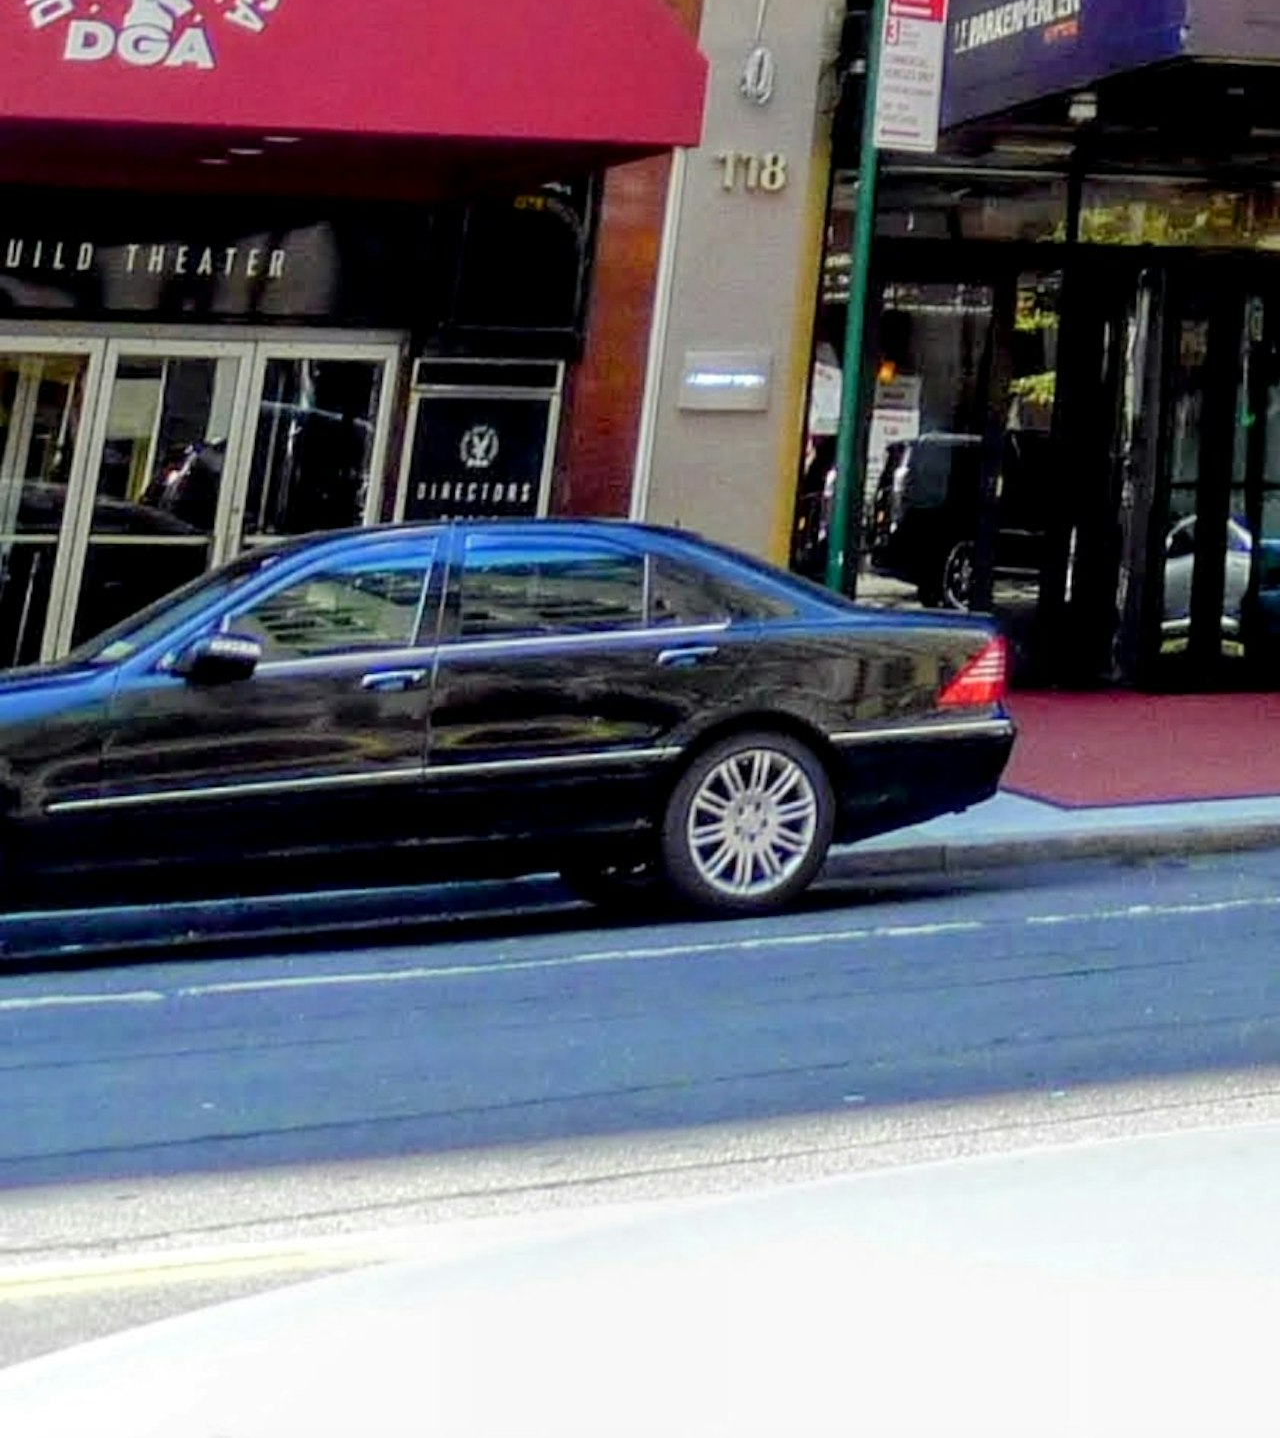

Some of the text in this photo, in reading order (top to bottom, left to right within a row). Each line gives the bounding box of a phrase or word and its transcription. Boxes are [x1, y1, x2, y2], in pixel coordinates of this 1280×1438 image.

[63, 19, 215, 70] DGA
[717, 149, 788, 192] 118
[125, 243, 287, 279] THEATER
[416, 480, 533, 504] DIRECTORS
